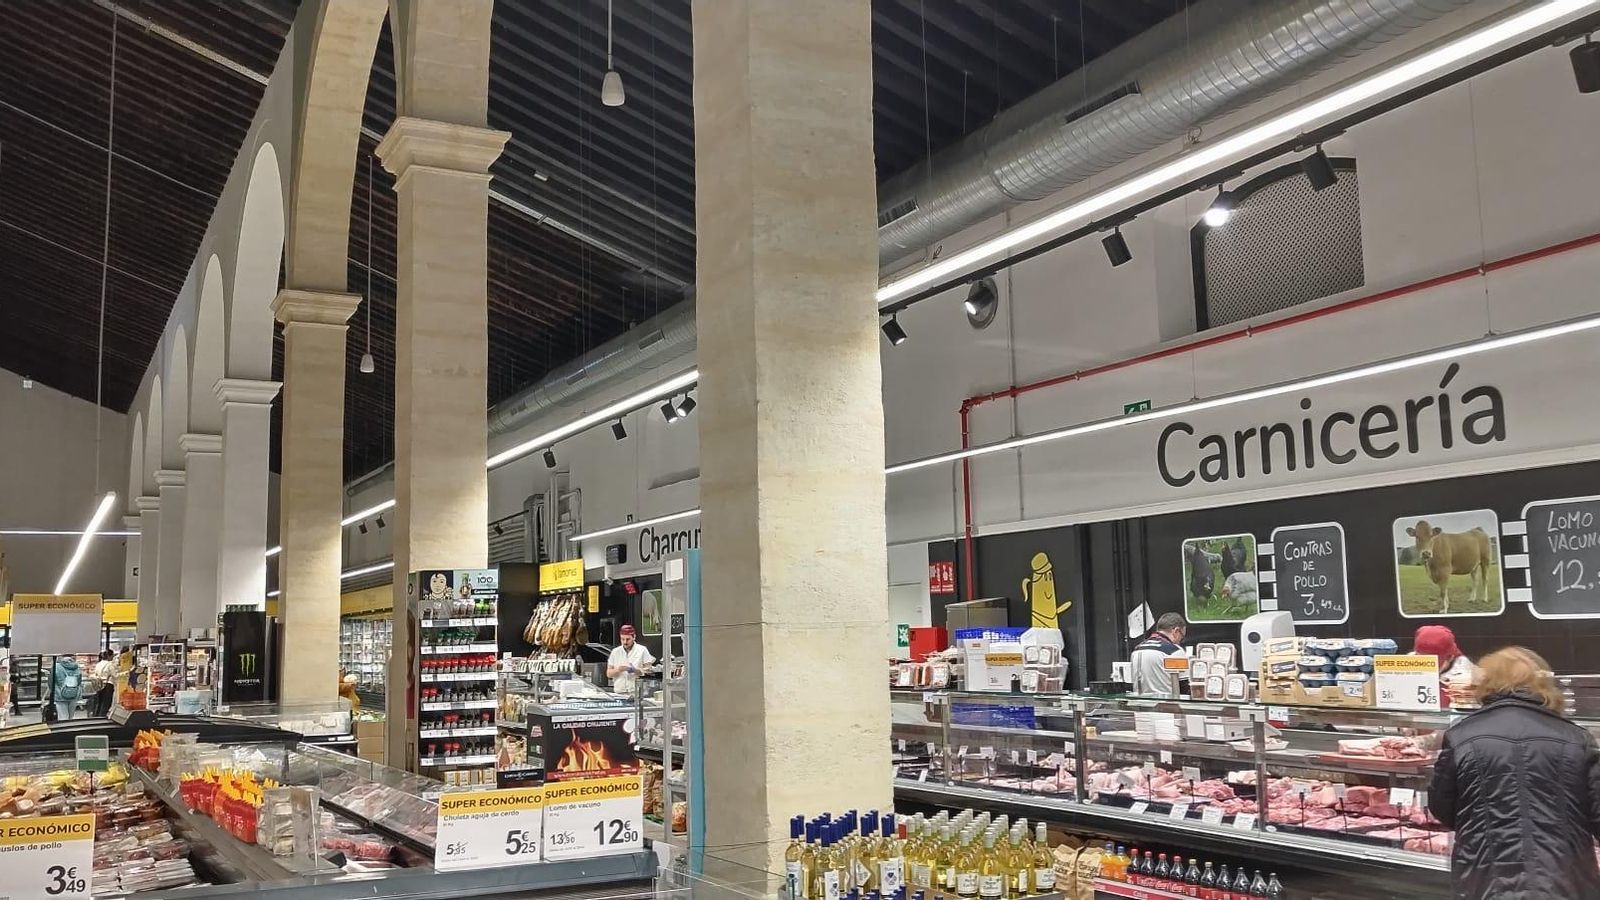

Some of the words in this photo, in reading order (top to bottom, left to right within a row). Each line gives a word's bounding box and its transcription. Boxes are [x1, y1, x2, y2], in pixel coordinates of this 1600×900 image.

[1157, 363, 1506, 487] Carnicería
[1548, 511, 1593, 531] LOMO
[1284, 541, 1332, 560] CONTRAS
[1548, 533, 1600, 552] VACUN
[1303, 561, 1314, 570] DE
[1294, 575, 1326, 590] POLLO
[1552, 559, 1600, 593] 12,
[47, 601, 96, 609] ECONÓMICO
[545, 788, 578, 799] SUPER
[580, 782, 640, 796] ECONÓMICO
[441, 800, 476, 810] SUPER
[479, 793, 542, 807] ECONÓMICO
[9, 823, 91, 837] ECONÓMICO
